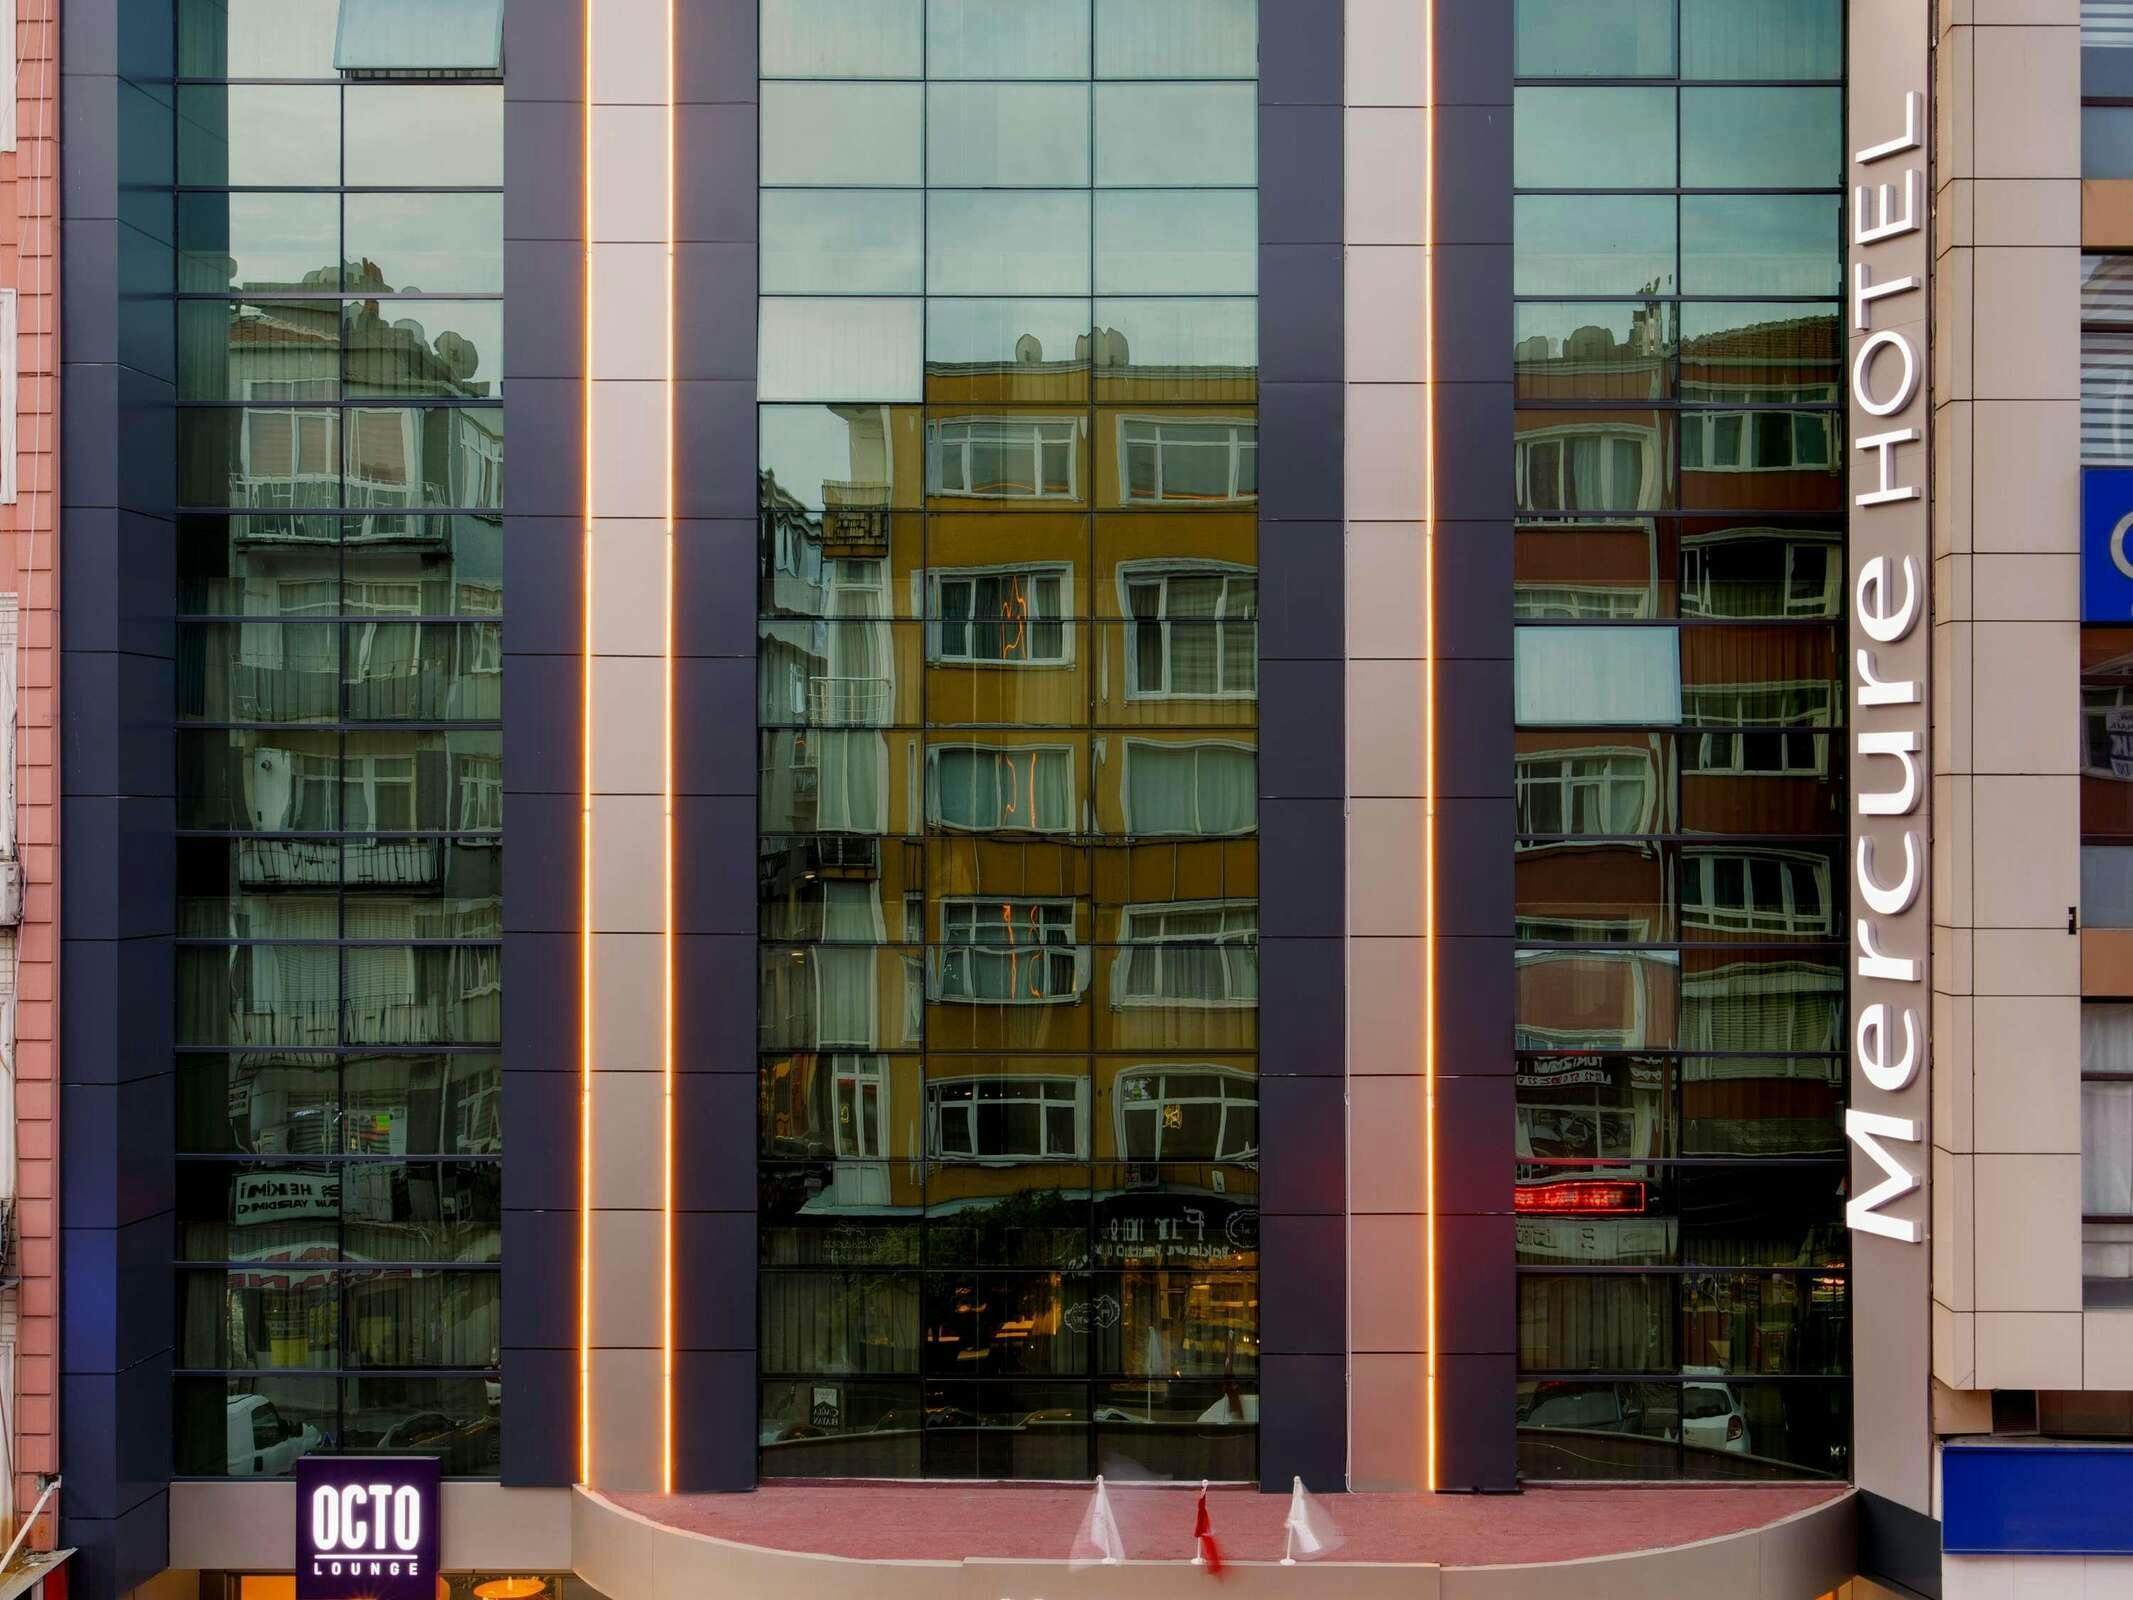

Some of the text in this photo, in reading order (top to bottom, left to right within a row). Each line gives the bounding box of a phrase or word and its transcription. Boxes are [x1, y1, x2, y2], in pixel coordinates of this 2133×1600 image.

[1845, 89, 1922, 1243] Mercure HOTEL
[313, 1484, 420, 1551] OCTO
[313, 1562, 418, 1575] LOUNGE
